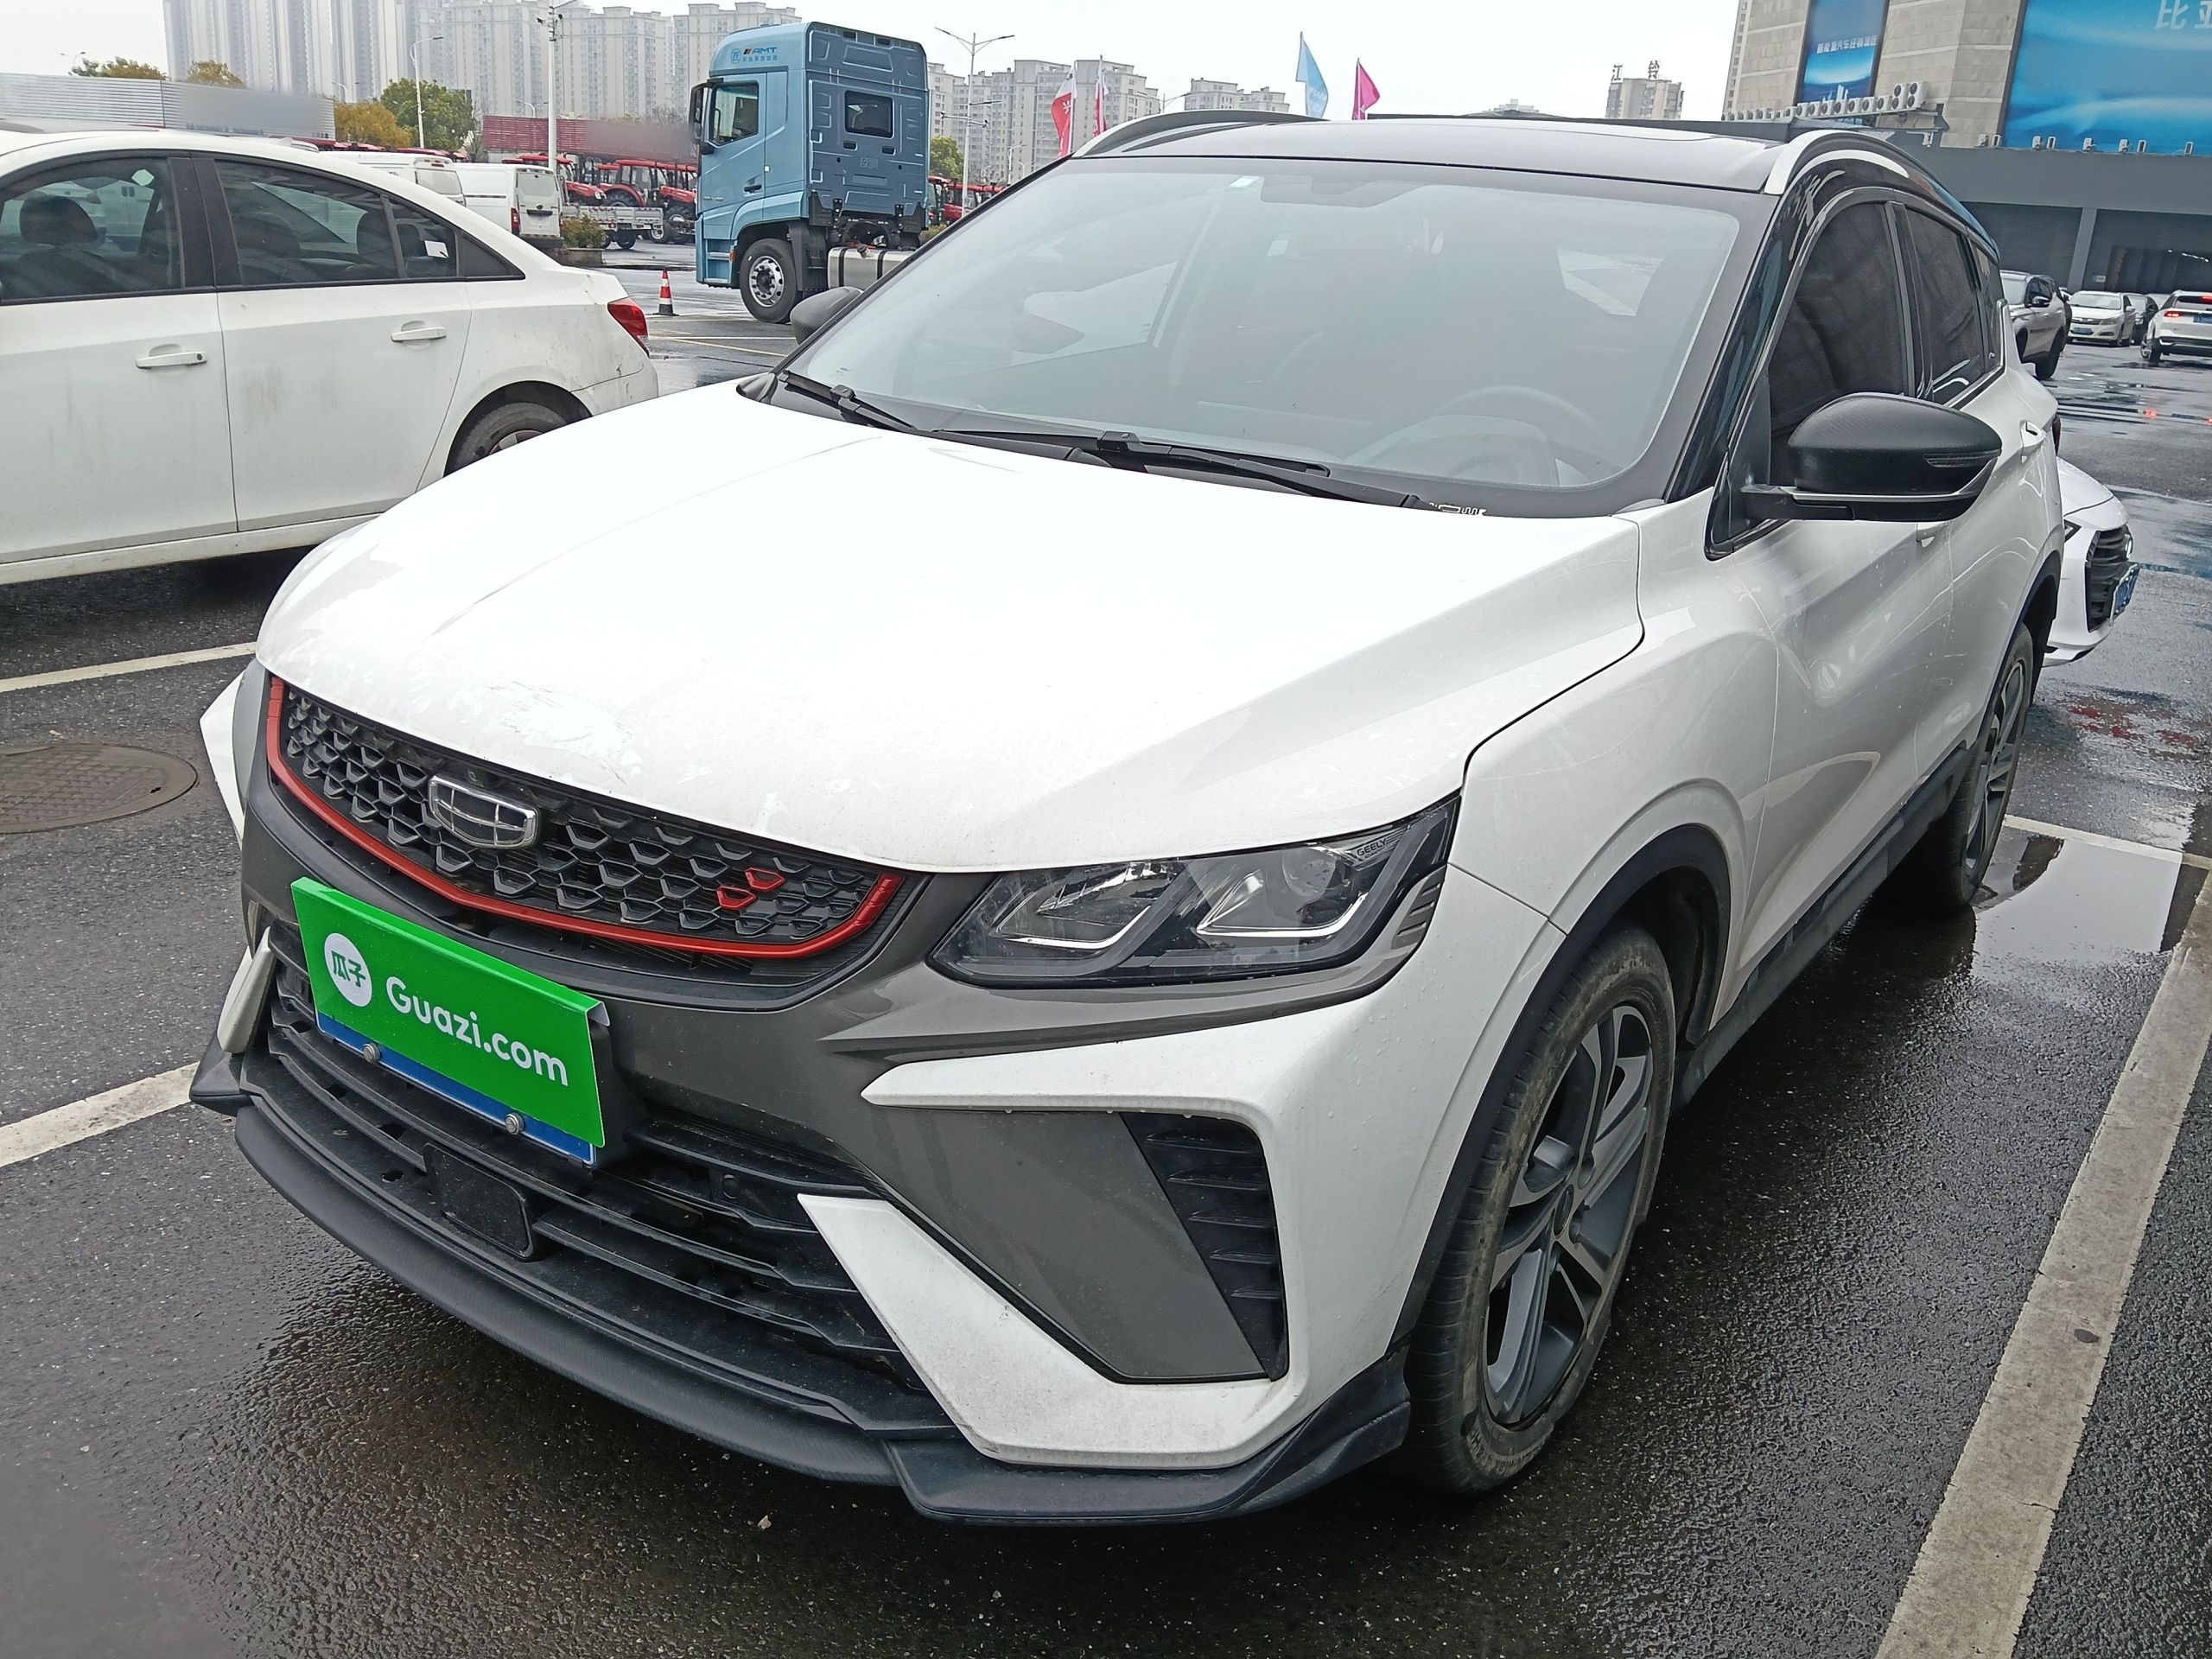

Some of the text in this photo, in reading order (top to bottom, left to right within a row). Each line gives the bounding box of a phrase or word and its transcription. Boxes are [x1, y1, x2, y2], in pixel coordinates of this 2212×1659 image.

[1357, 838, 1387, 856] GEELY
[331, 950, 366, 988] 瓜子
[385, 976, 569, 1087] Guazi.com
